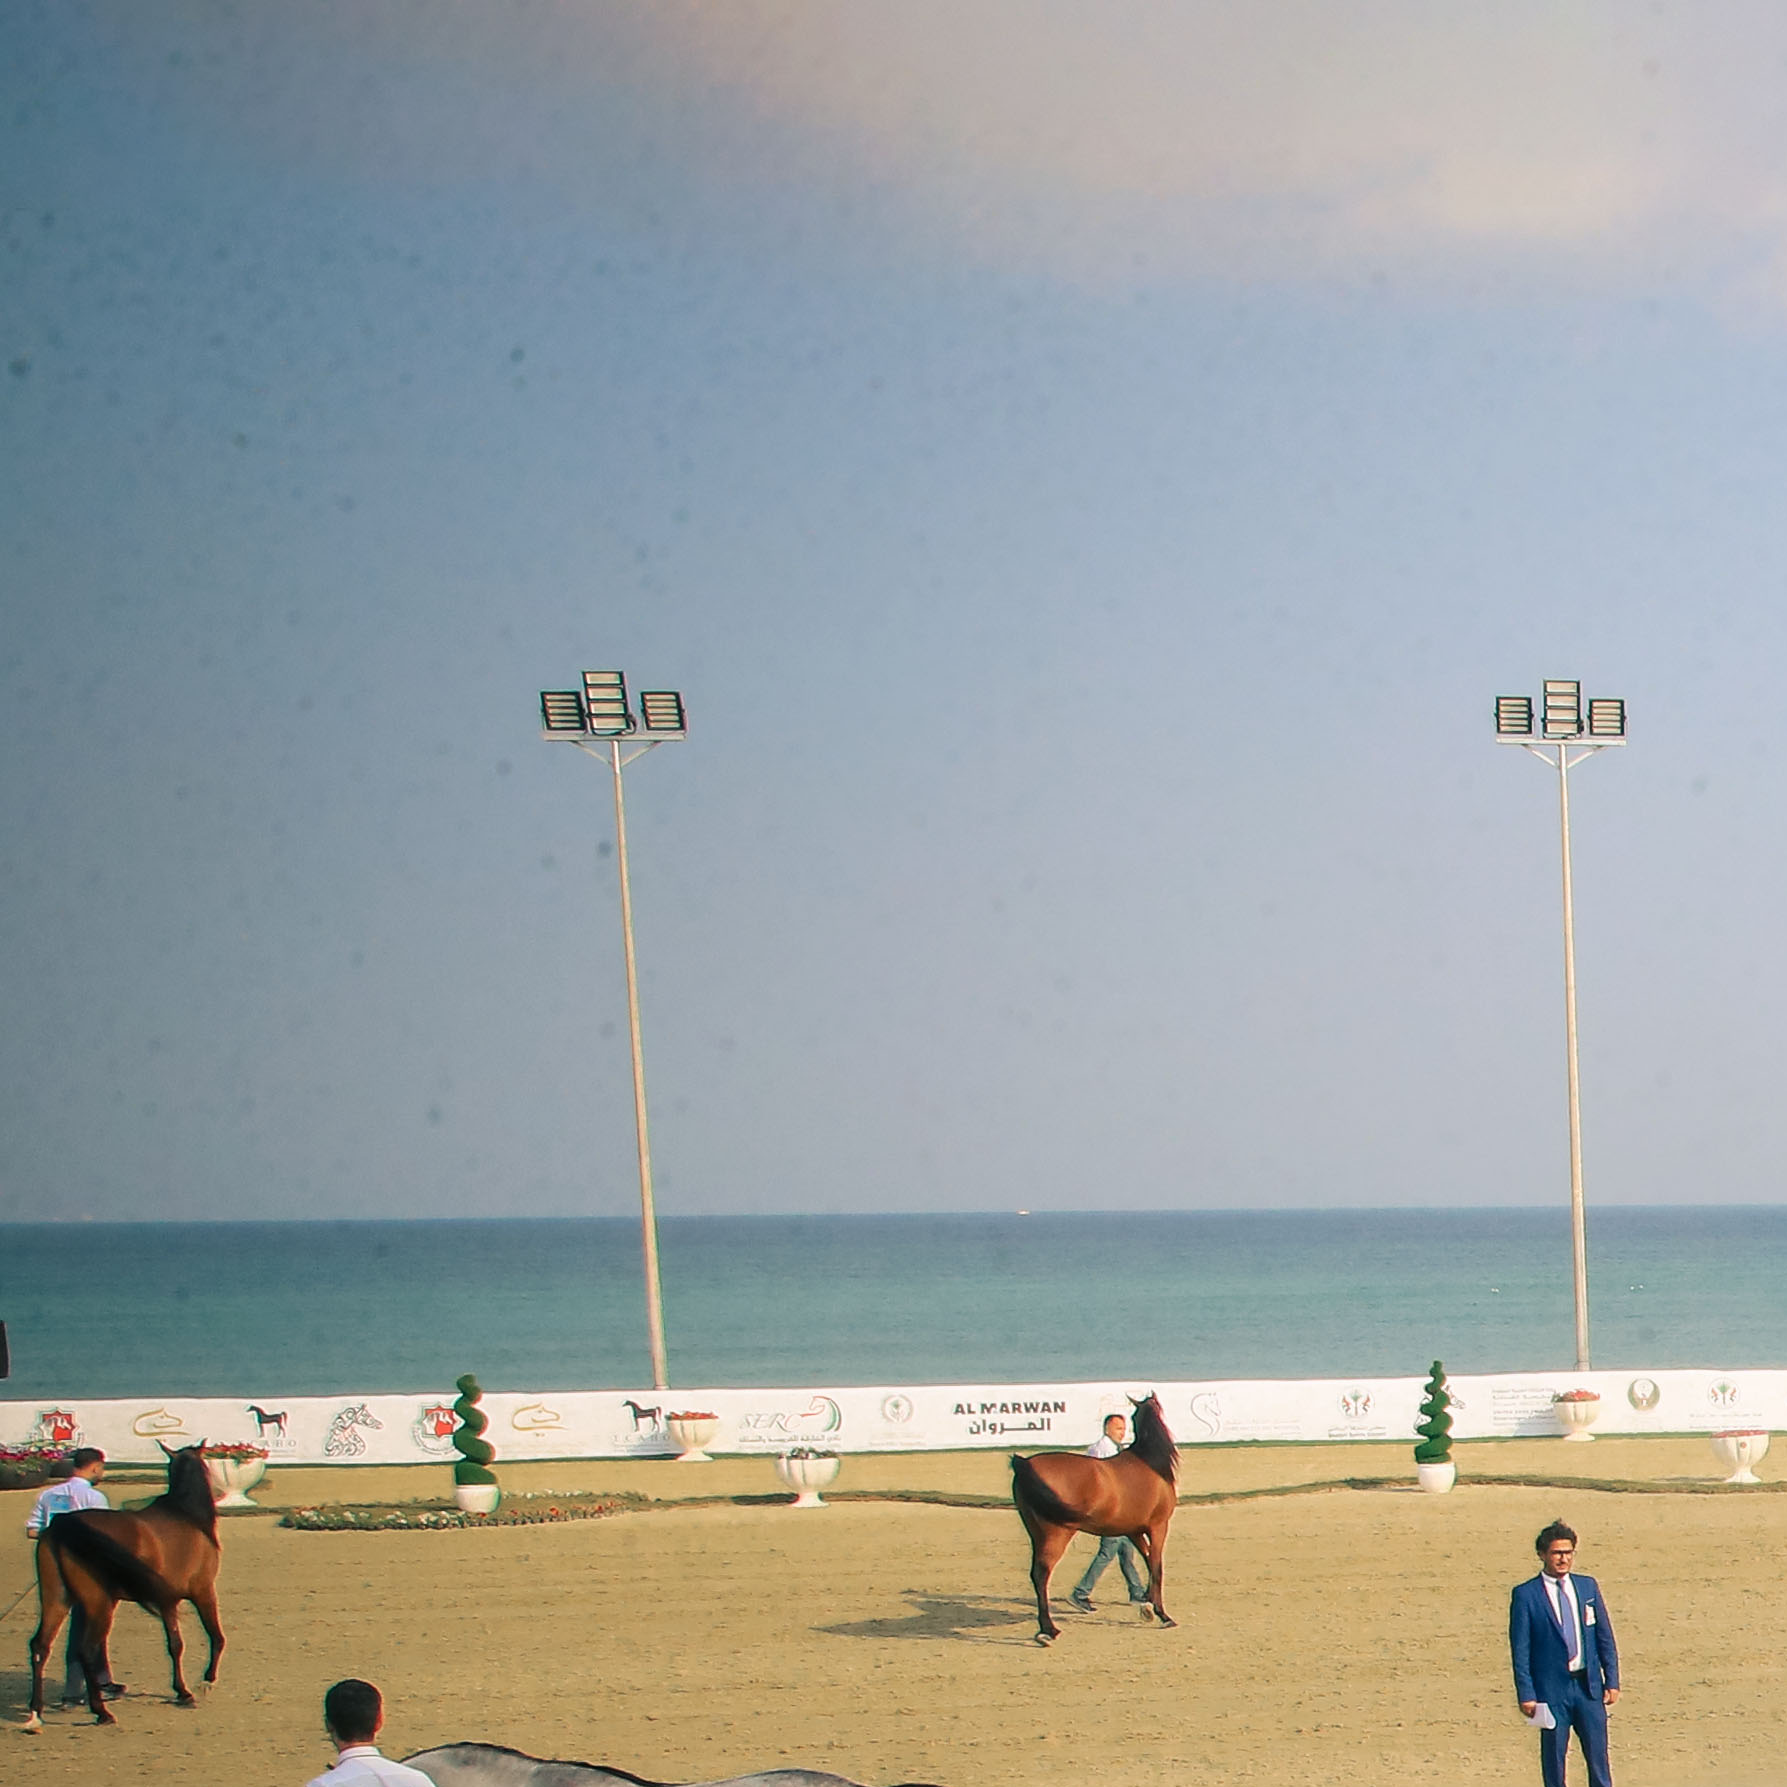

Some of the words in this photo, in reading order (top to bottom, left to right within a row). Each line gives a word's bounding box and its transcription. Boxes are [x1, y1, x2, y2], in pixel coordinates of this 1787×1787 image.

[953, 1402, 975, 1415] AL
[980, 1401, 1067, 1415] MARWAN
[968, 1417, 1052, 1435] المروان
